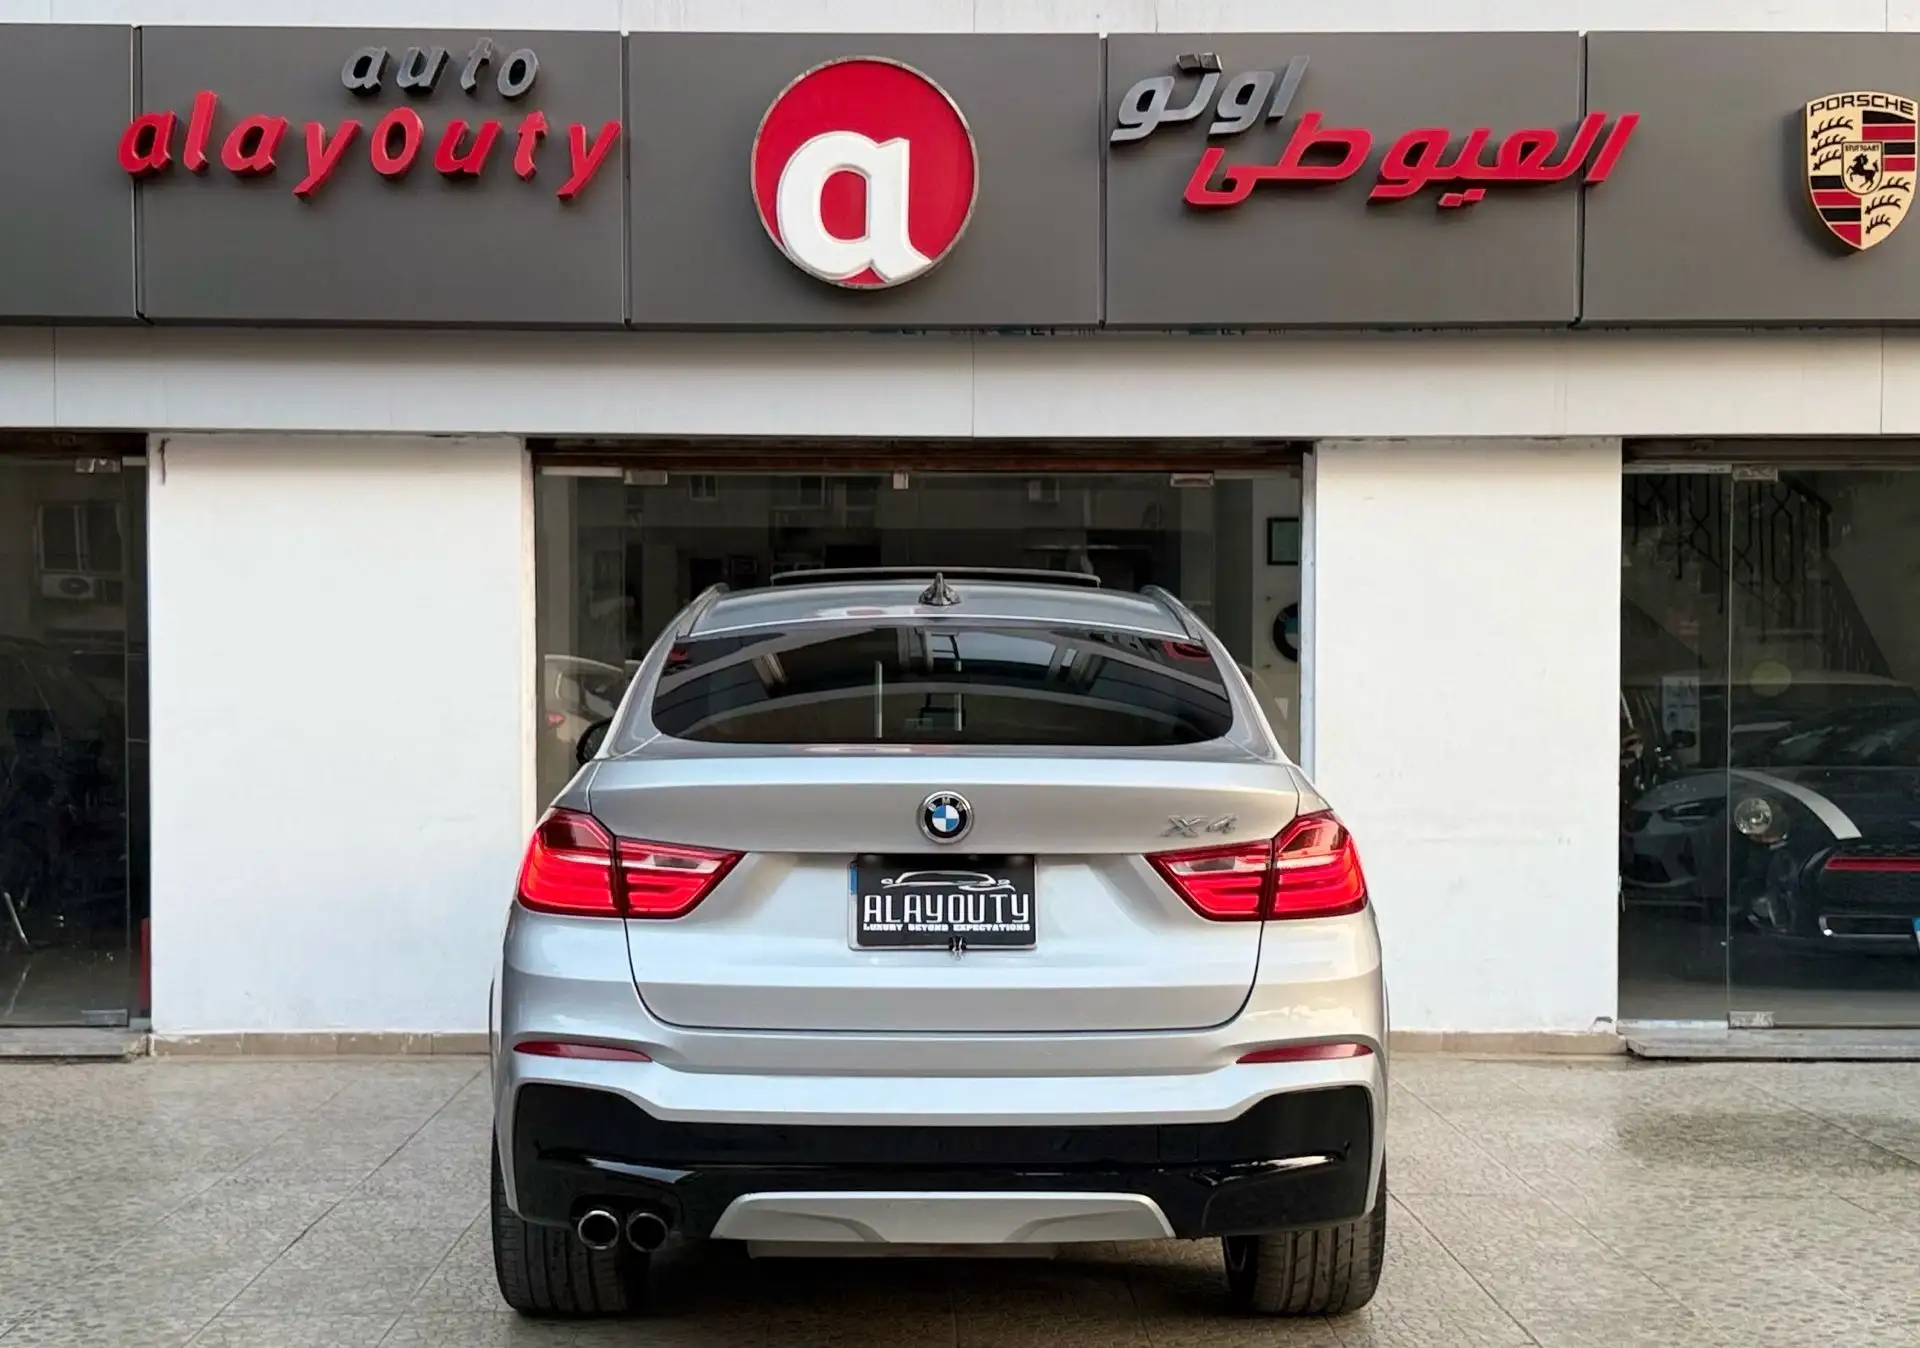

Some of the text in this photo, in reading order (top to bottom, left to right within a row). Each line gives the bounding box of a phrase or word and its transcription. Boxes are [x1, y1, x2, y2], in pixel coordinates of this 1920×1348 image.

[341, 38, 540, 98] auto
[1810, 94, 1914, 116] PORSCHE
[776, 130, 932, 284] a
[928, 796, 966, 812] BMW
[1161, 814, 1238, 838] X4
[864, 894, 1029, 923] ALAYOUTY
[863, 923, 1030, 931] LUXURY BEYOND EXPECTATIONS
